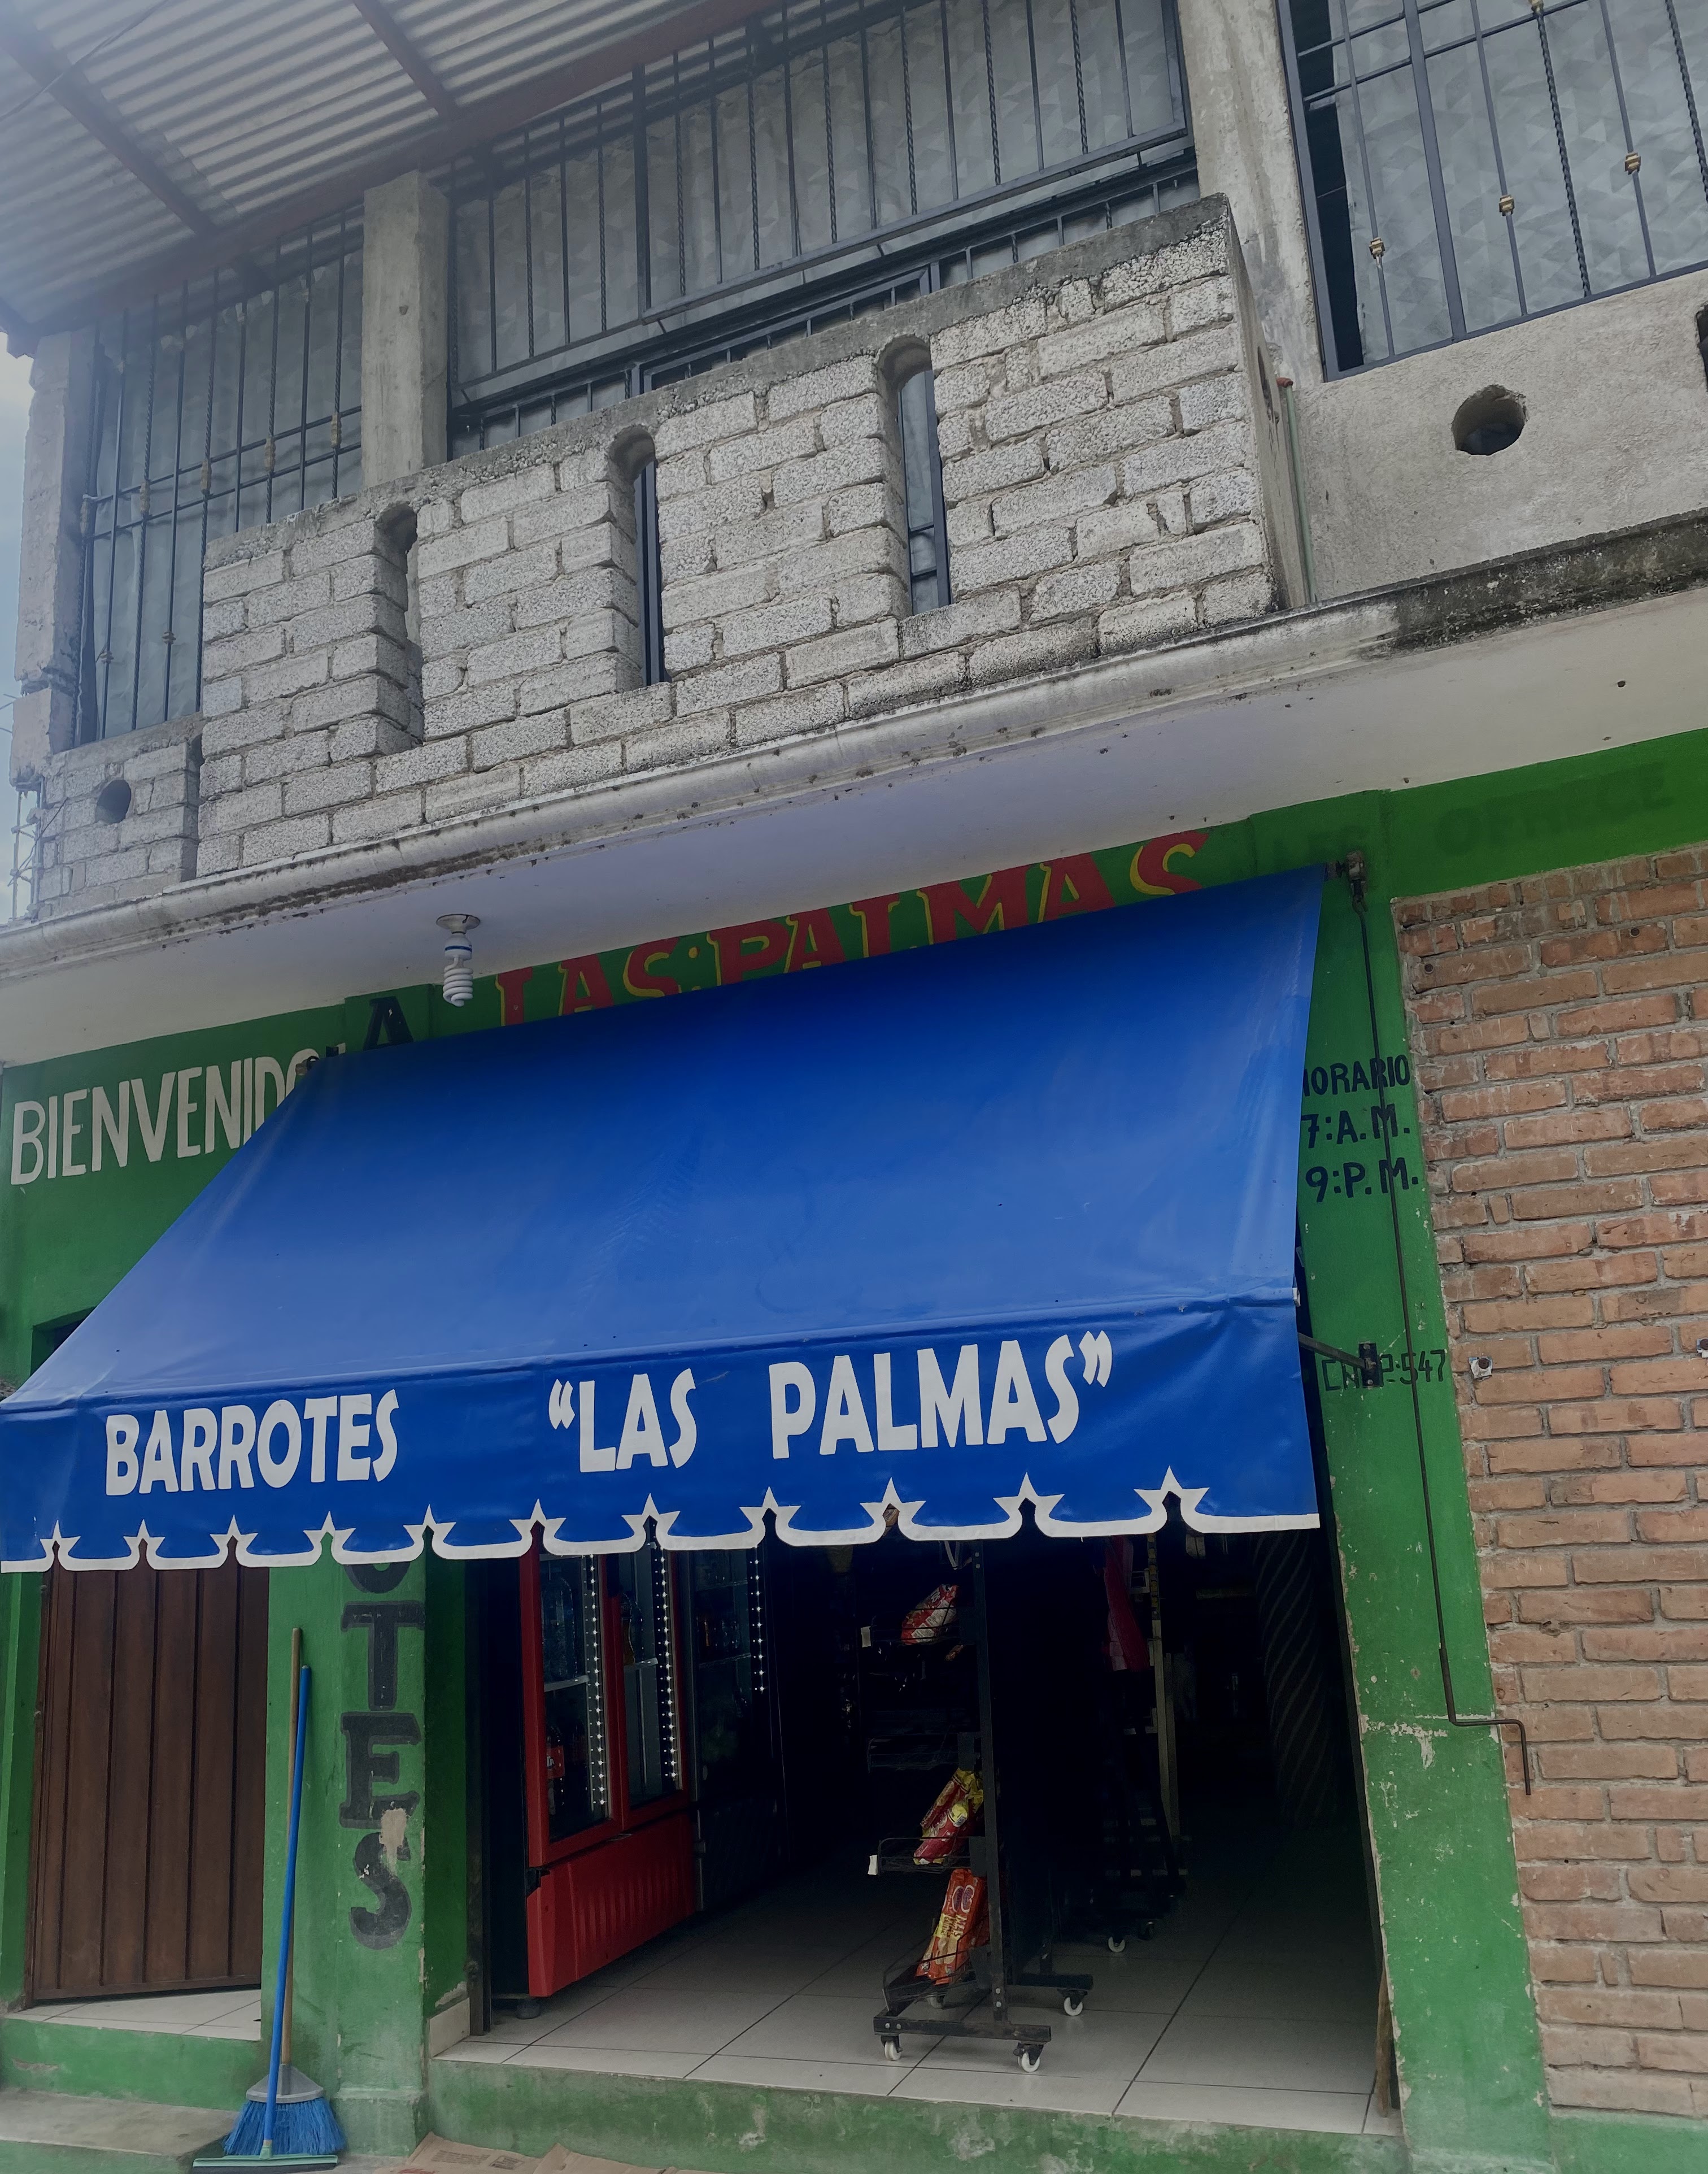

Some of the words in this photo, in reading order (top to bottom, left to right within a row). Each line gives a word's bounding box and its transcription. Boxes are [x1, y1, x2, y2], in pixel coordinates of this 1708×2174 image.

[10, 1043, 346, 1185] BIENVENID
[1305, 1157, 1418, 1203] 9:P.M.
[106, 1389, 399, 1495] BARROTES
[548, 1368, 697, 1473] “LAS
[768, 1329, 1112, 1459] PALMAS”
[340, 1562, 425, 1950] TES
